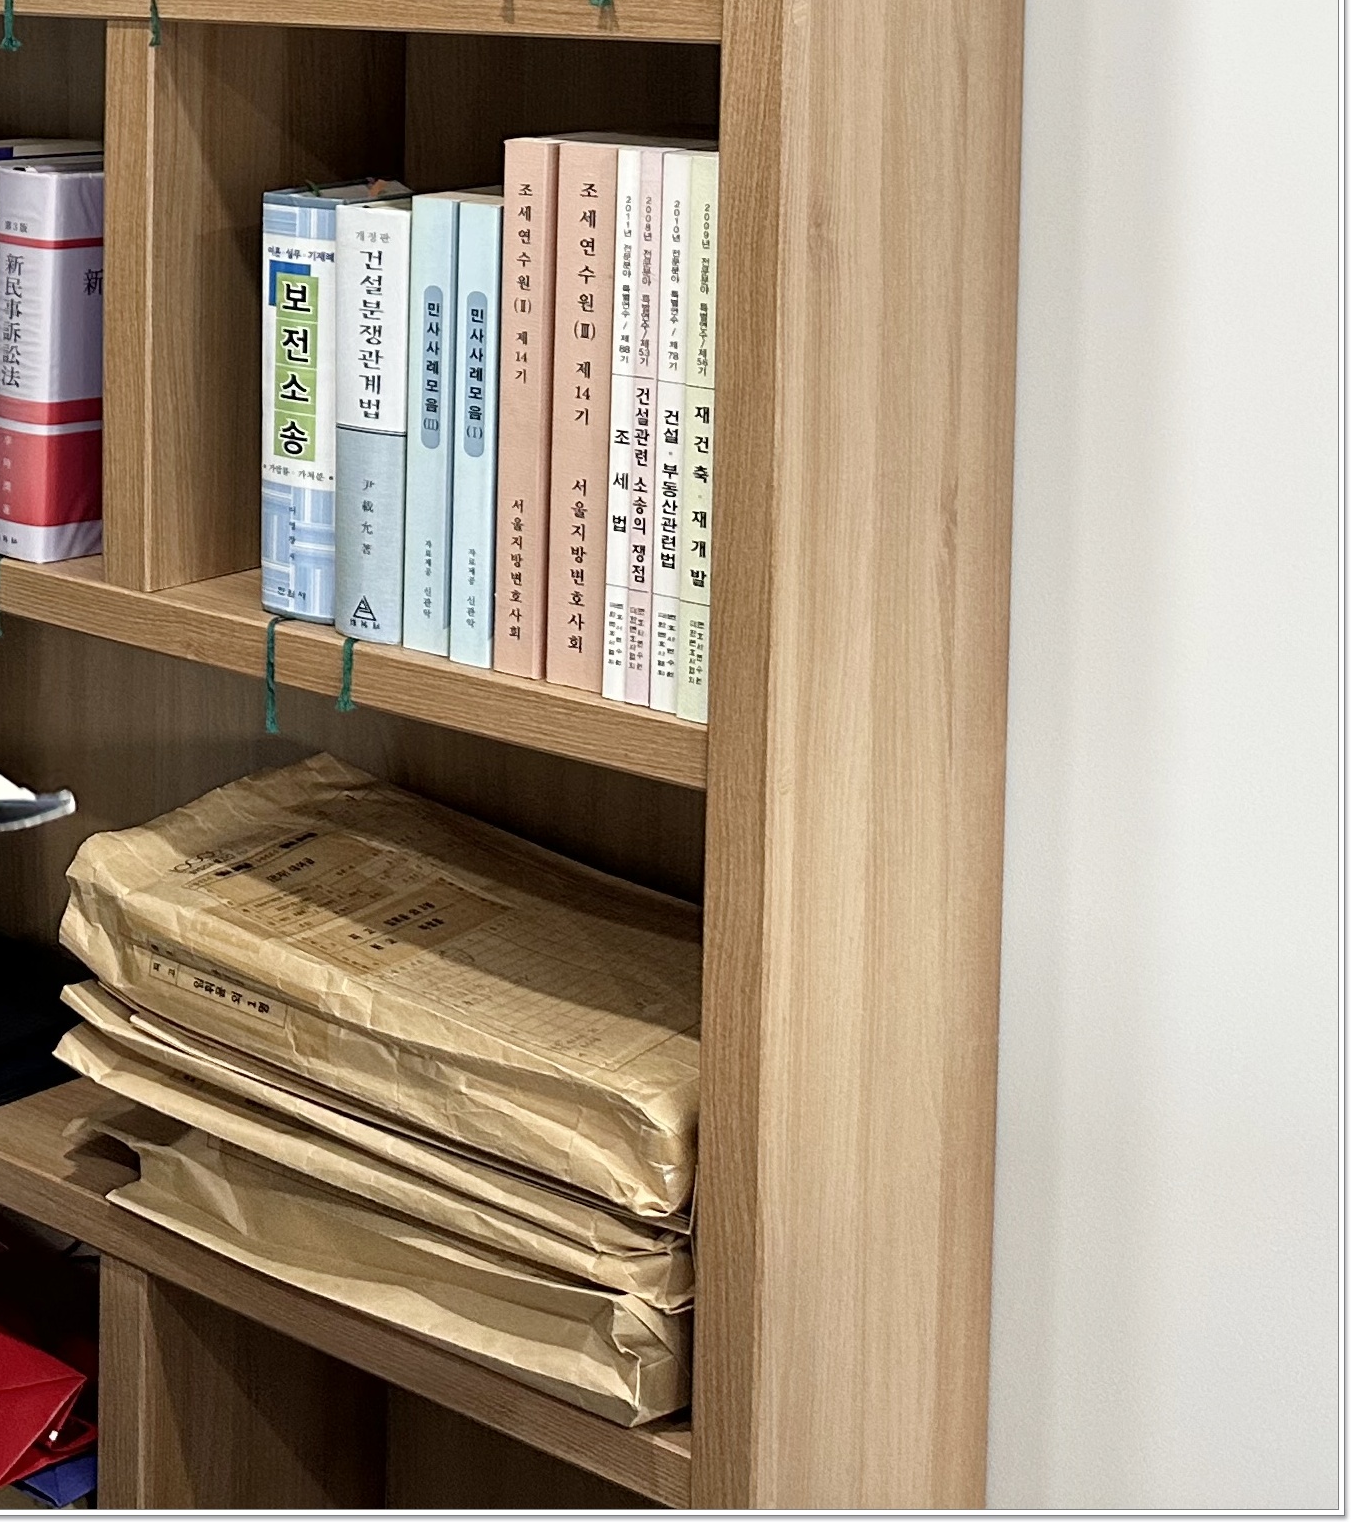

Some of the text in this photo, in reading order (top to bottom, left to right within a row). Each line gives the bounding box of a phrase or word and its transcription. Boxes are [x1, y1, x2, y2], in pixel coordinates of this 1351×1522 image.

[355, 231, 391, 244] 개정판
[1, 253, 24, 388] 新民事訴訟法
[278, 281, 312, 455] 보전소송
[358, 250, 384, 420] 건설분쟁관계법
[515, 330, 528, 384] 제14기
[574, 361, 591, 426] 제14기
[612, 429, 631, 534] 조세법
[631, 387, 650, 584] 건설관련 소송의 쟁점
[660, 409, 679, 570] 건설 부동산관련법
[690, 406, 710, 588] 재건축 재개발
[509, 499, 525, 641] 서울지방변호사회
[567, 479, 588, 654] 서울지방변호사회
